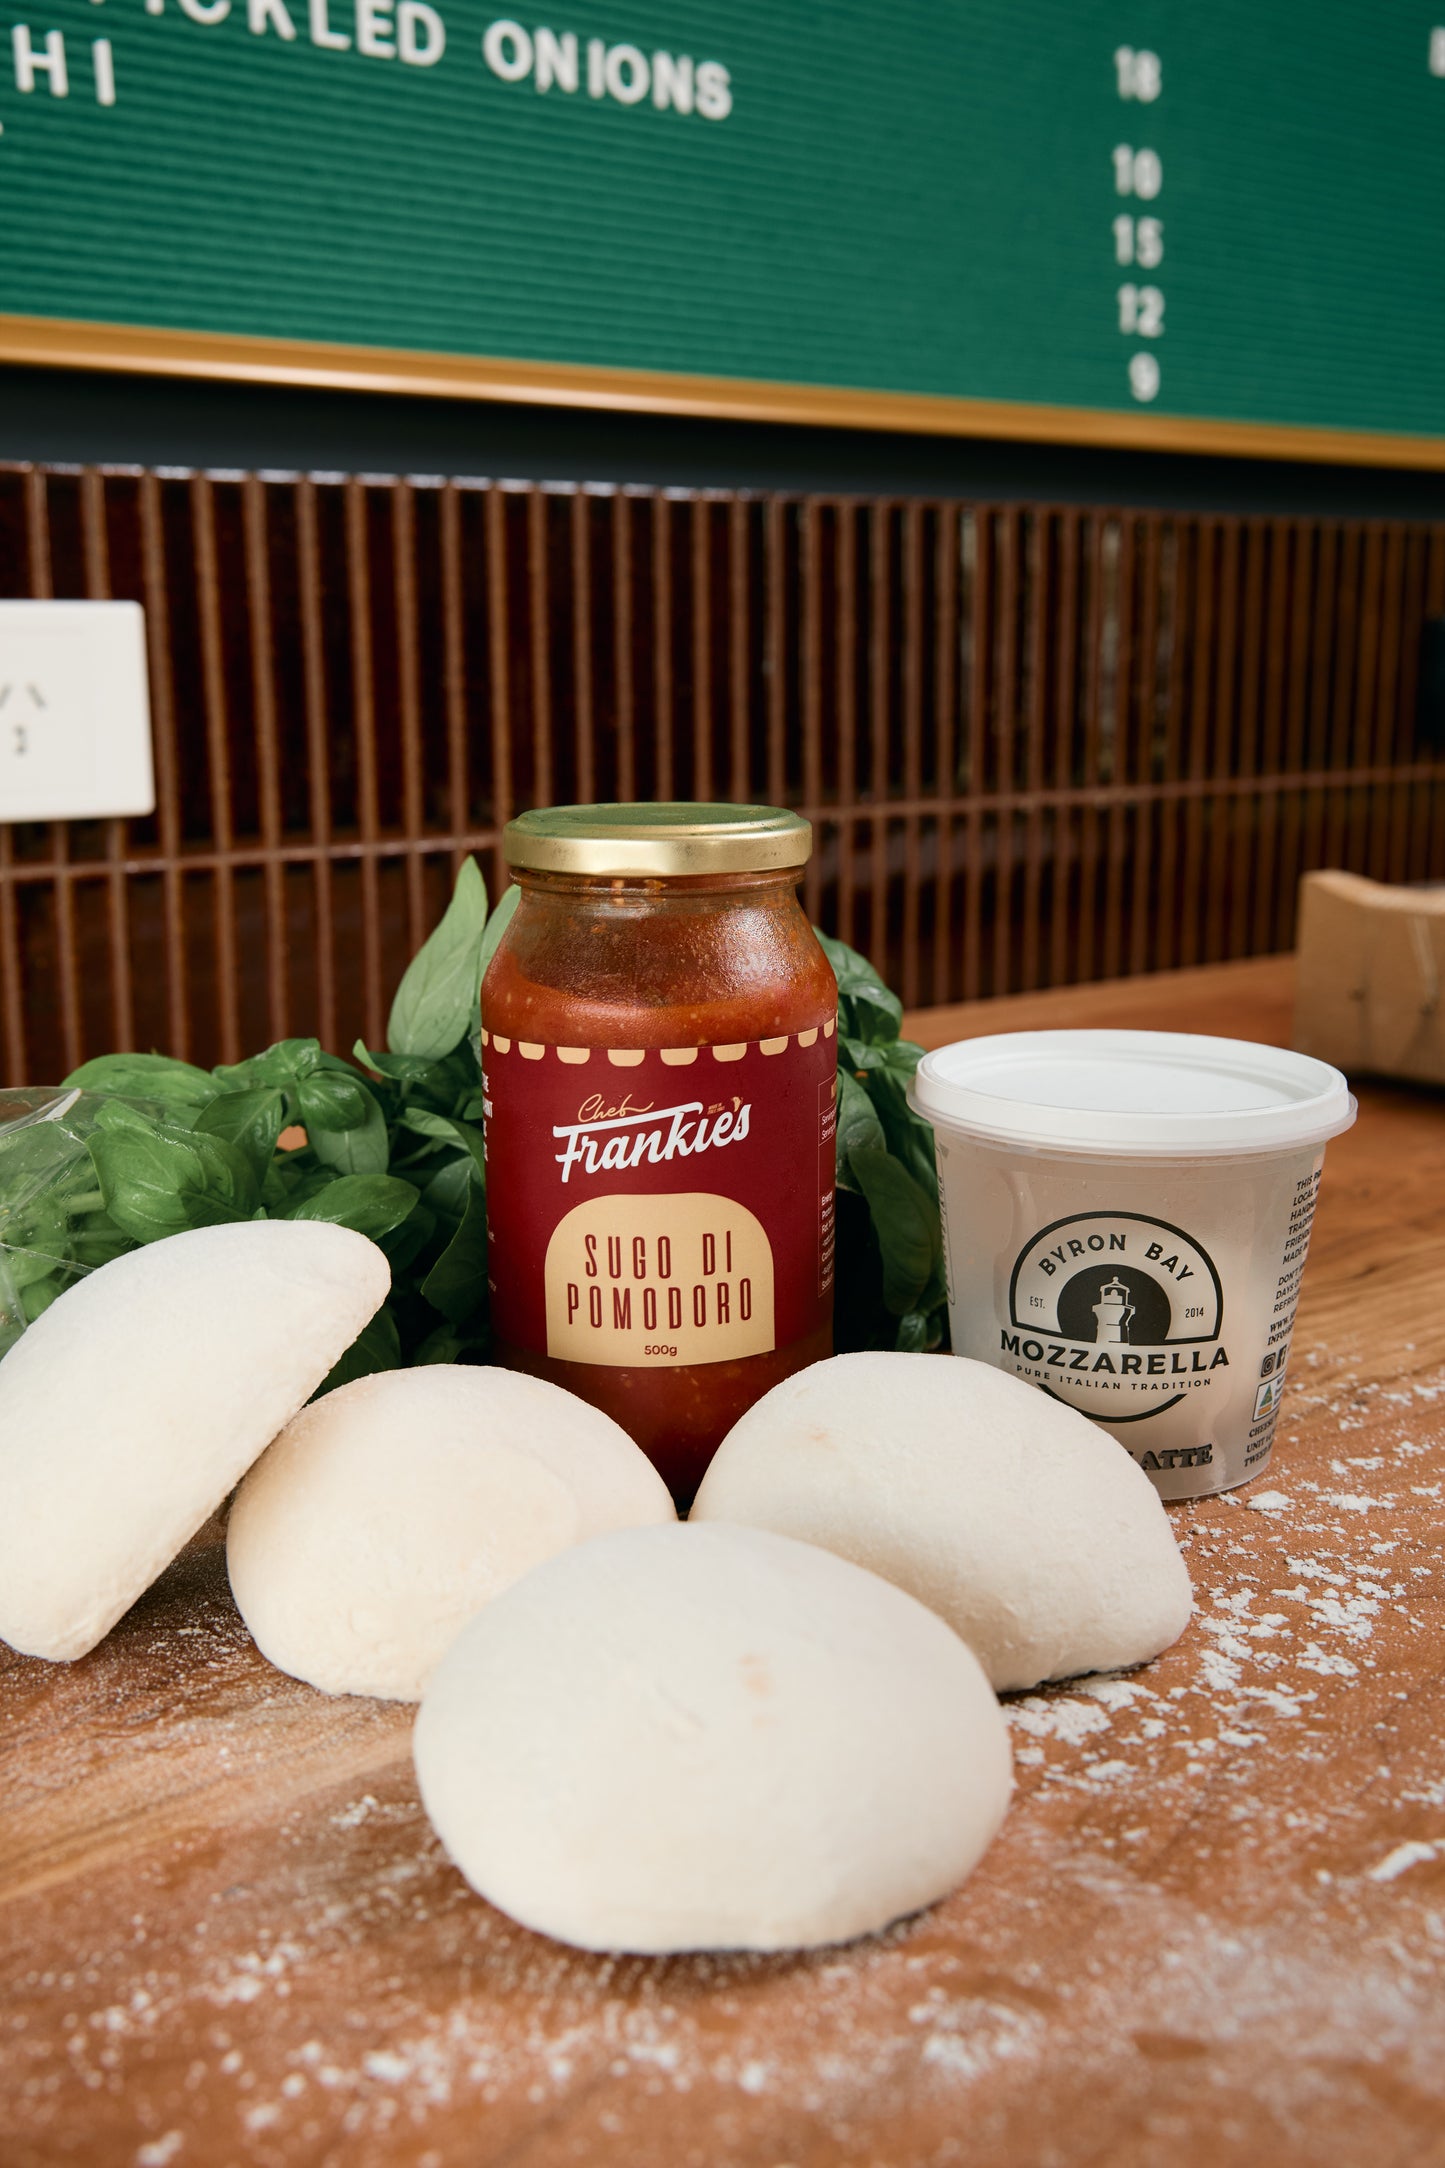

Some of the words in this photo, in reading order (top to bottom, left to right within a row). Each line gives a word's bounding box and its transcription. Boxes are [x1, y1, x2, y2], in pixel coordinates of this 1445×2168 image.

[483, 19, 732, 120] ONIONS
[1113, 145, 1162, 199] 10
[1114, 214, 1163, 268] 15
[1118, 284, 1164, 338] 12
[577, 1093, 654, 1123] Chef
[1293, 1187, 1314, 1207] LOCAL
[1296, 1174, 1314, 1192] THIS
[584, 1234, 671, 1280] SUGO
[702, 1230, 732, 1277] DI
[1037, 1233, 1127, 1277] BYRON
[1144, 1242, 1195, 1284] BAY
[1282, 1244, 1304, 1265] MADE
[567, 1277, 752, 1331] POMODORO
[1029, 1295, 1046, 1310] EST.
[1184, 1306, 1205, 1319] 2014
[644, 1344, 678, 1357] 500g
[1000, 1329, 1230, 1376] MOZZARELLA
[1015, 1364, 1051, 1381] PURE
[1059, 1375, 1122, 1390] ITALIAN
[1130, 1377, 1212, 1391] TRADITION
[1127, 1443, 1214, 1471] ATTE
